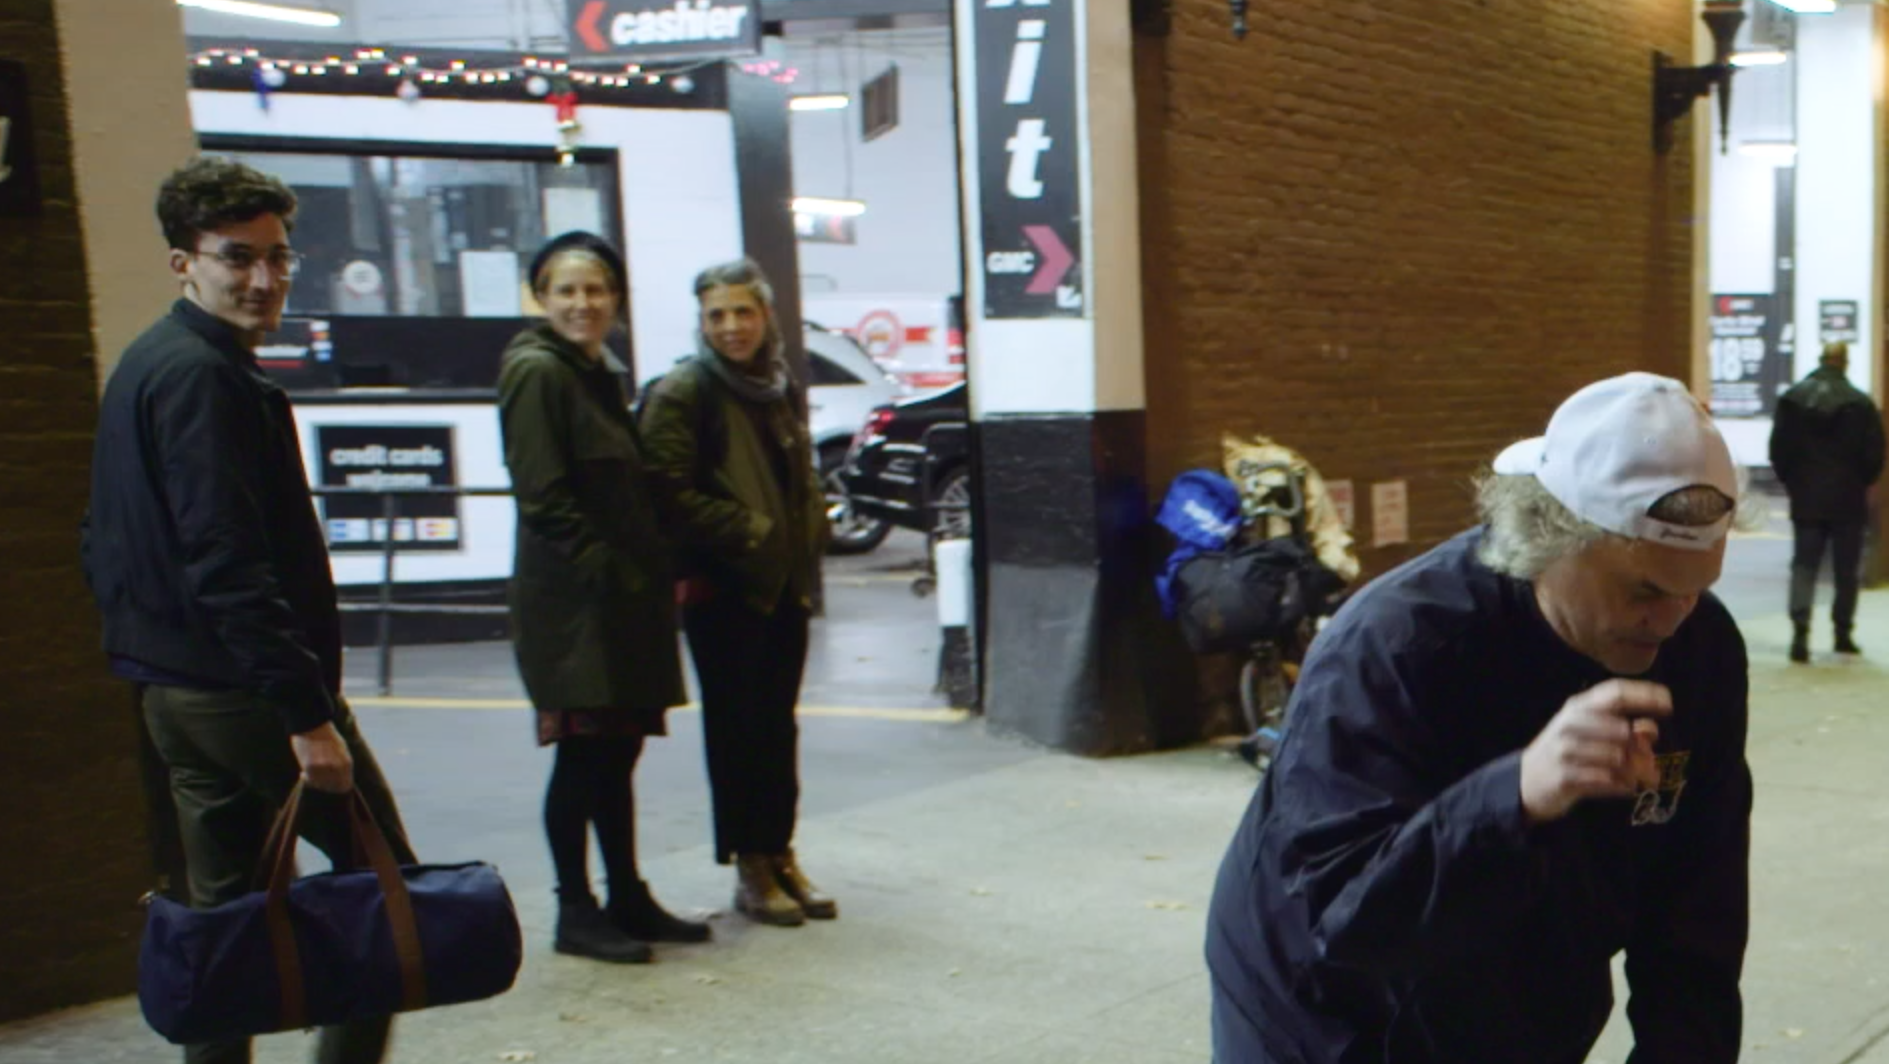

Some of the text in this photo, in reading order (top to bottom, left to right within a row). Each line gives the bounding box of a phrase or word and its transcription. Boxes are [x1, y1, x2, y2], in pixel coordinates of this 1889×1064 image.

[611, 0, 747, 44] cashier
[984, 0, 1052, 199] it
[329, 444, 443, 466] credit cards
